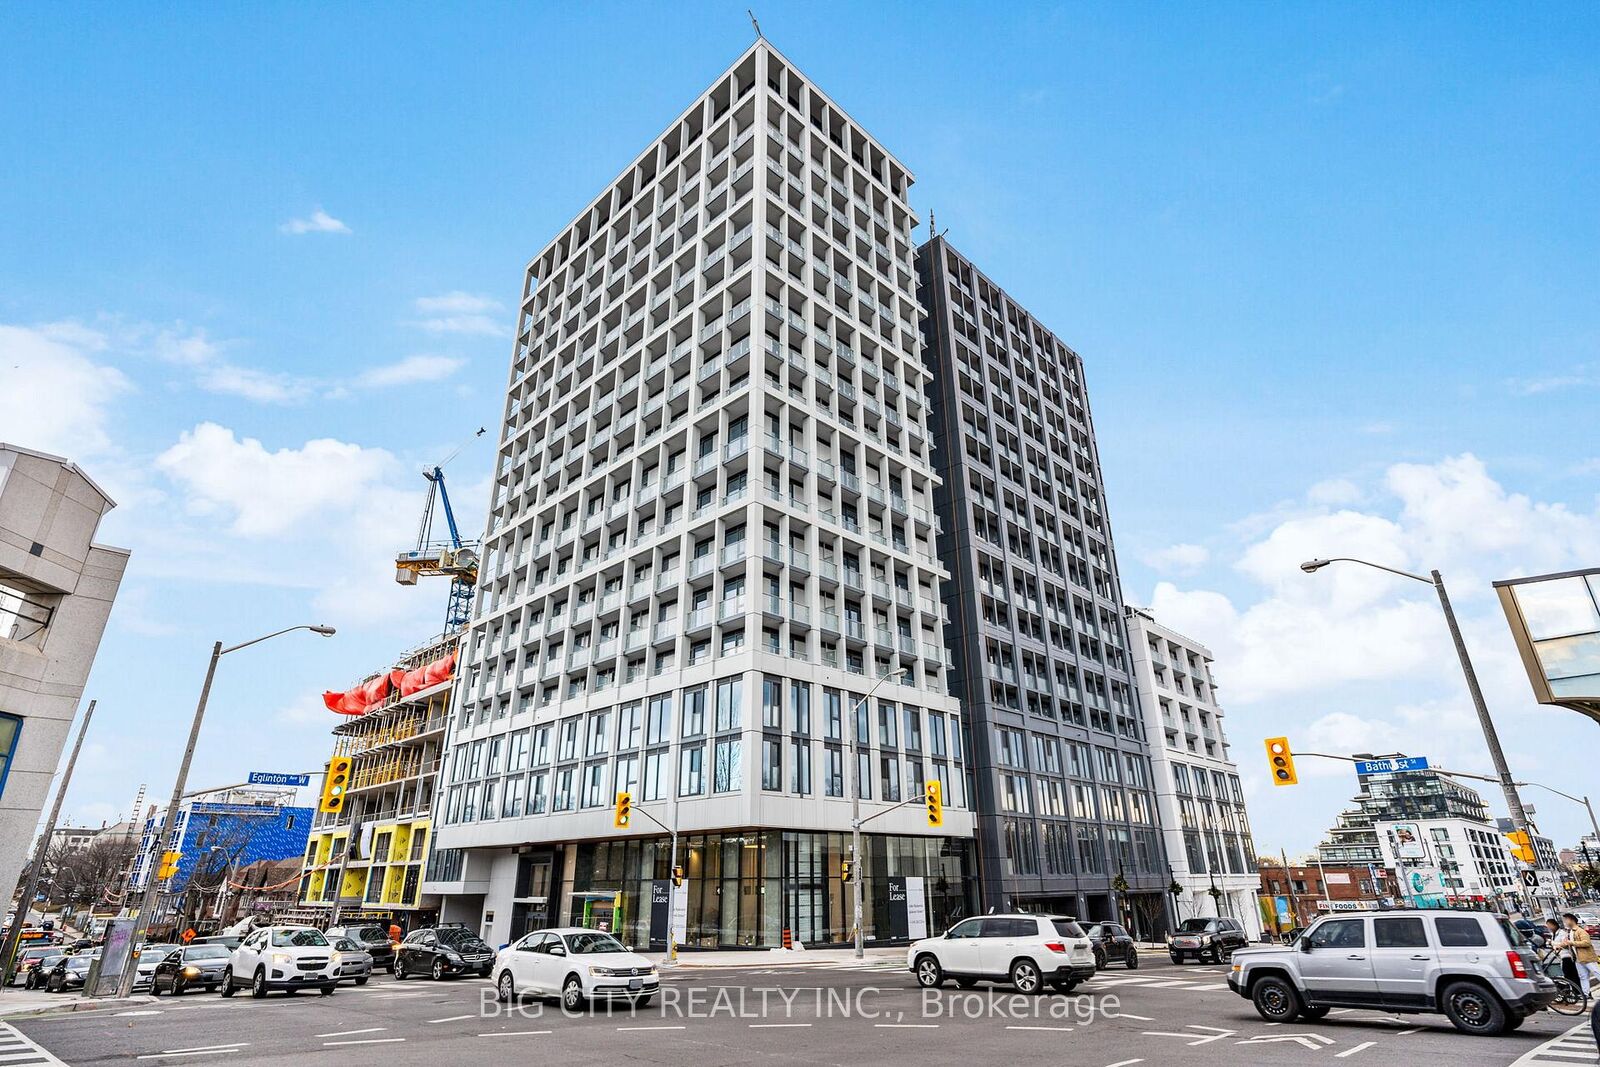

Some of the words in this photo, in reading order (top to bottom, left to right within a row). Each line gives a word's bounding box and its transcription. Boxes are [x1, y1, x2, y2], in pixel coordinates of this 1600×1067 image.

[1366, 760, 1409, 772] Bathst
[252, 773, 287, 784] Eglinton
[298, 775, 306, 784] W
[653, 885, 663, 894] For
[889, 882, 898, 891] For
[652, 894, 668, 903] Lease
[890, 892, 906, 900] Lease
